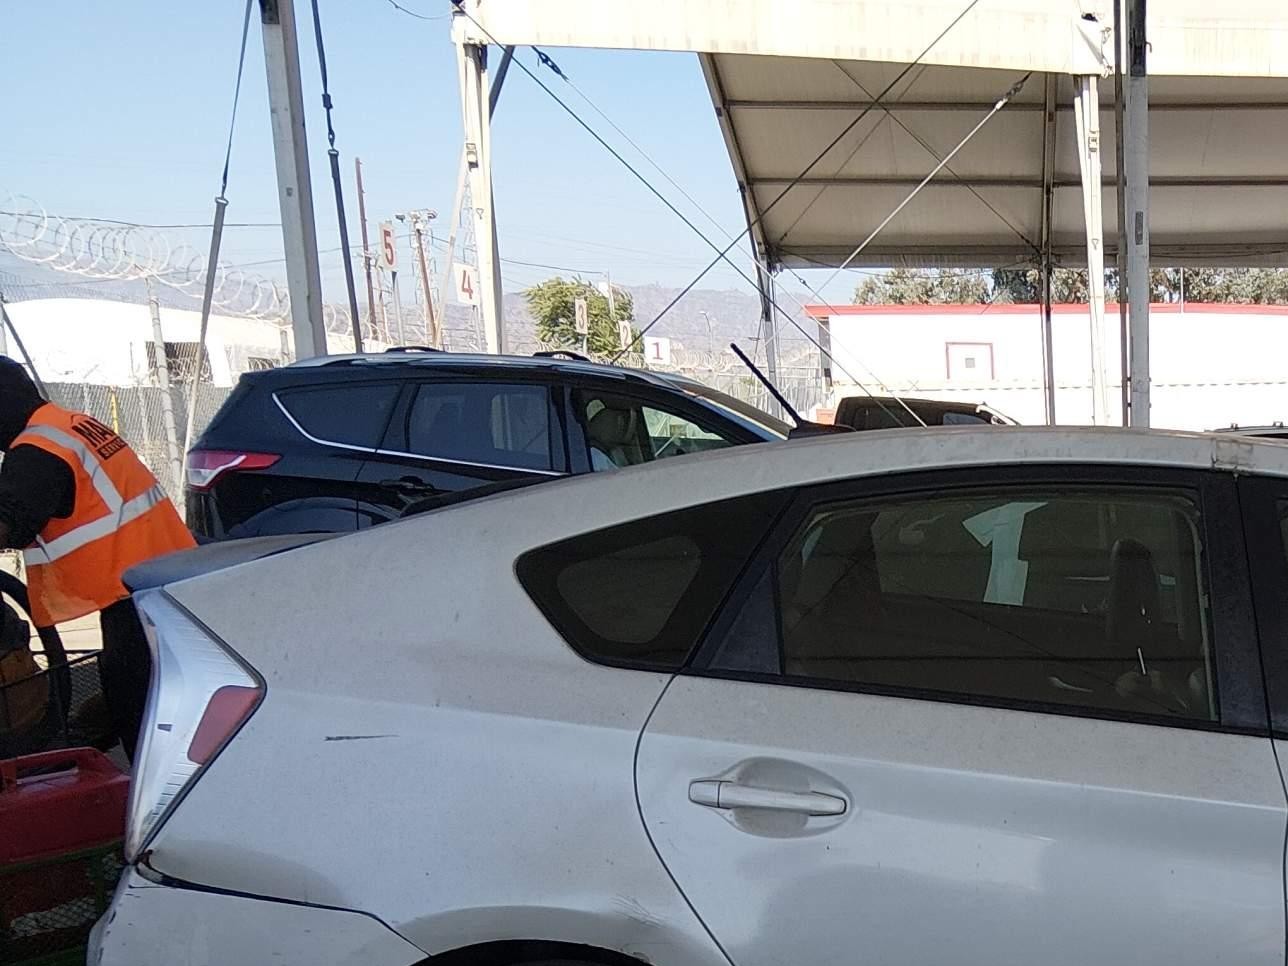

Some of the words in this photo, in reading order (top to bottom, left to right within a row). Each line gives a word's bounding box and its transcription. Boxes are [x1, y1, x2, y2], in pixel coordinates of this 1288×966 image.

[383, 229, 395, 266] 5
[461, 269, 474, 300] 4
[578, 304, 585, 329] 3
[622, 325, 629, 347] 2
[651, 341, 664, 360] 1
